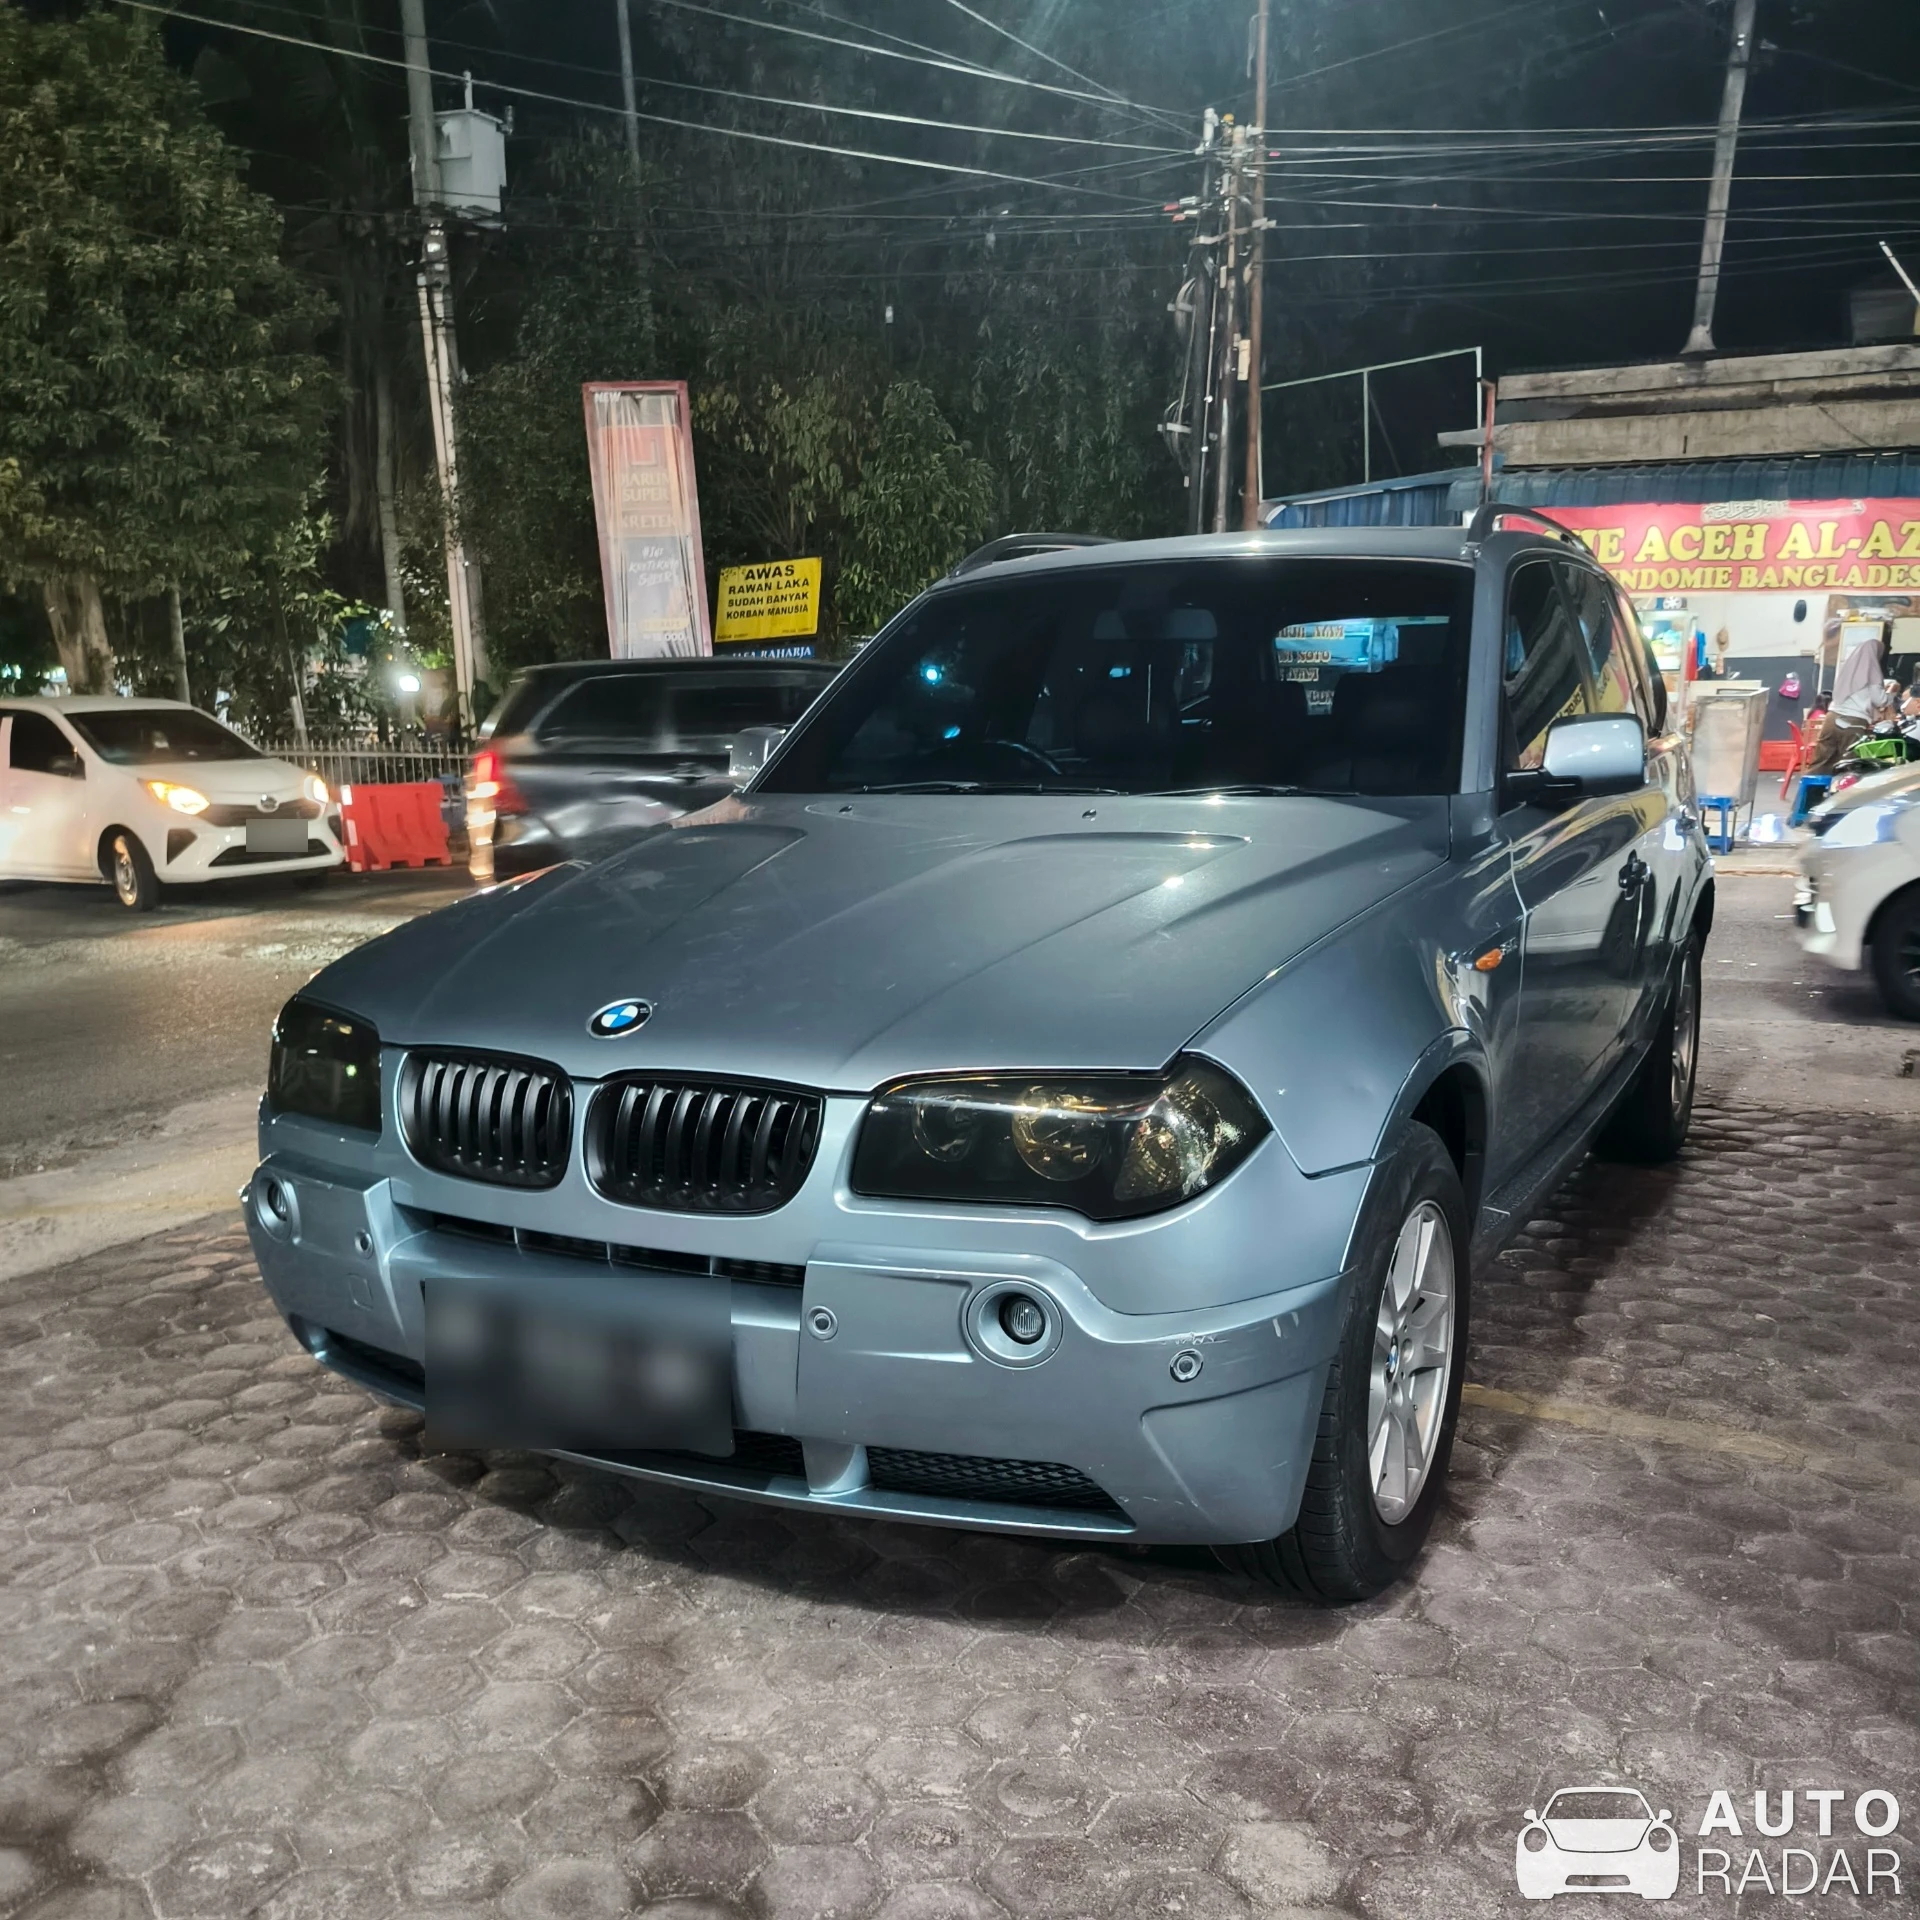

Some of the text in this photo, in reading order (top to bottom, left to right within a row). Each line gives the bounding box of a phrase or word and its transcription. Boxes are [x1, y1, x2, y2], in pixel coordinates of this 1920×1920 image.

[622, 487, 670, 502] SUPER
[1544, 520, 1920, 564] IE ACEH AL-AZ
[745, 565, 795, 580] AWAS
[1738, 564, 1920, 589] BANGLADES
[728, 578, 809, 595] RAWAN LAKA
[728, 592, 809, 607] SUDAH BANYAK
[726, 604, 809, 620] KORBAN MANUSIA
[761, 646, 812, 659] RAHARJA
